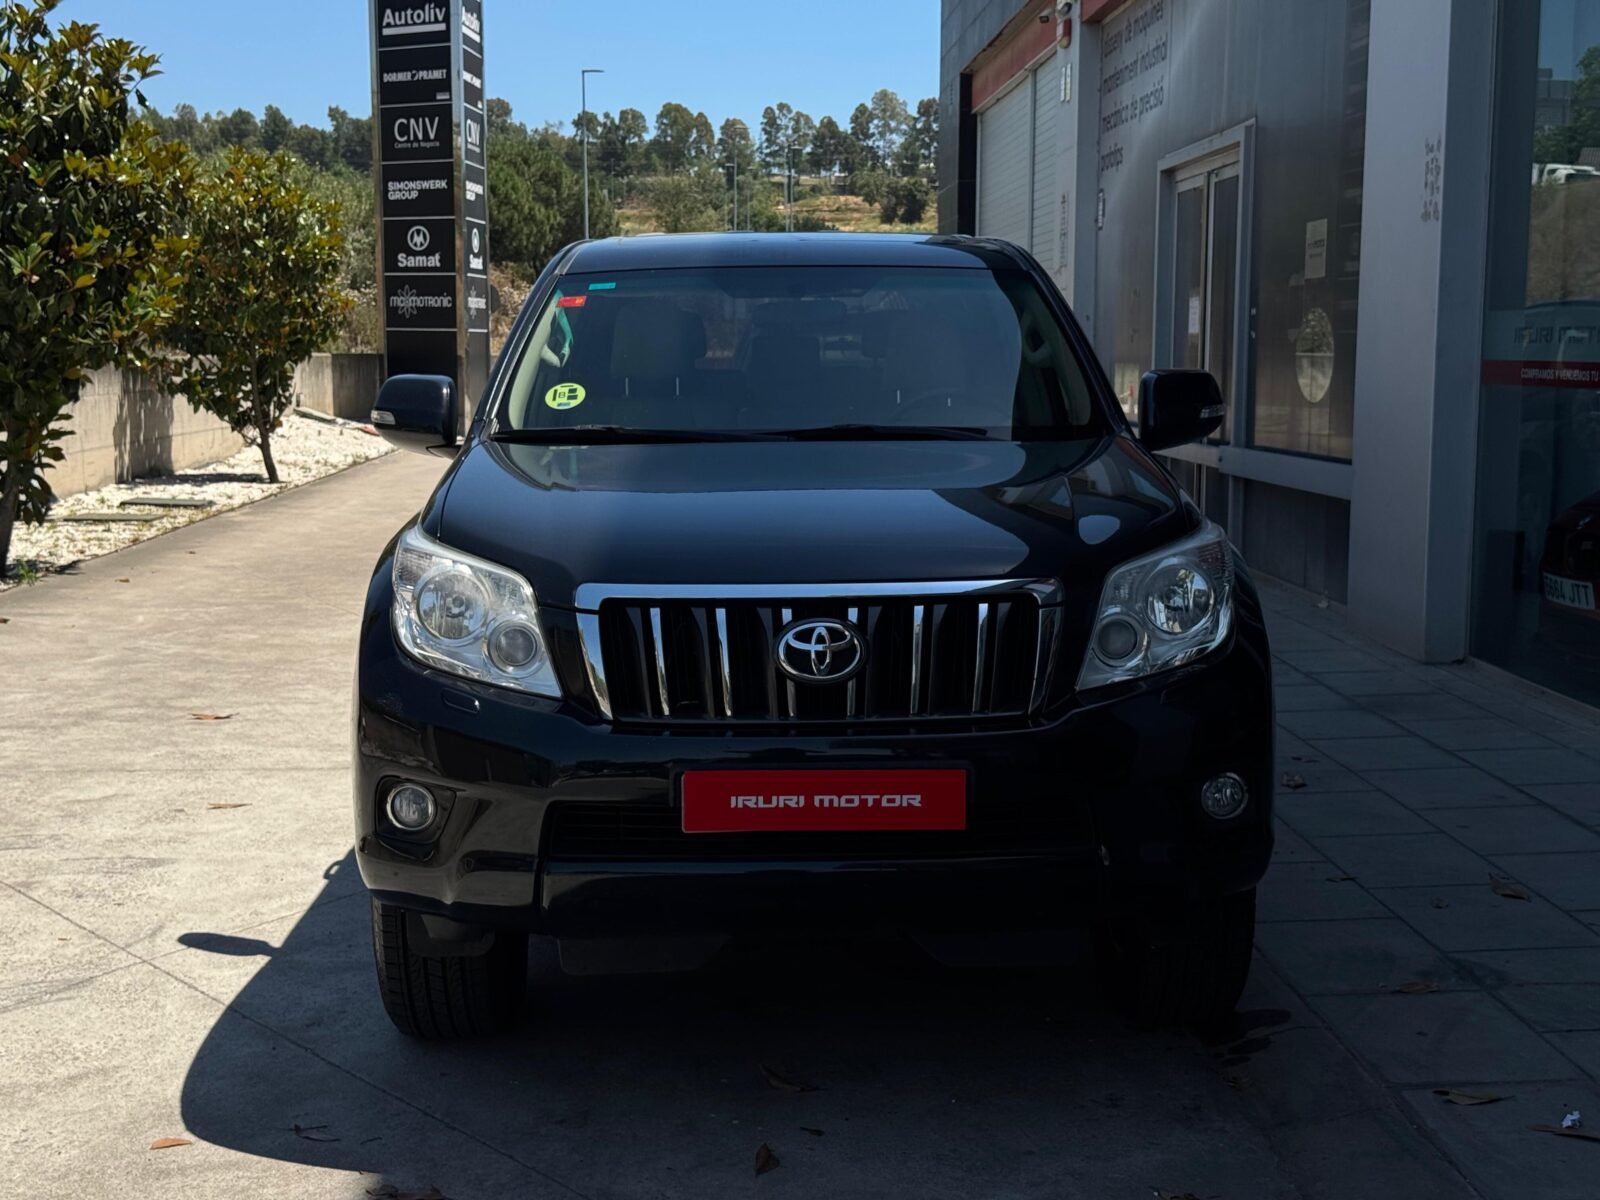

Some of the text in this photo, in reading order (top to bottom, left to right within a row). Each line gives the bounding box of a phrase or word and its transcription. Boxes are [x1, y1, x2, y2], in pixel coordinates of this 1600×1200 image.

[382, 3, 446, 27] Autoliv
[383, 69, 447, 83] DORMER PRAMET
[394, 116, 439, 142] CNV
[387, 179, 448, 191] SIMONSWERK
[388, 190, 419, 200] GROUP
[397, 252, 441, 268] Samat
[1568, 583, 1590, 607] JTT
[730, 794, 922, 808] IRURI MOTOR
